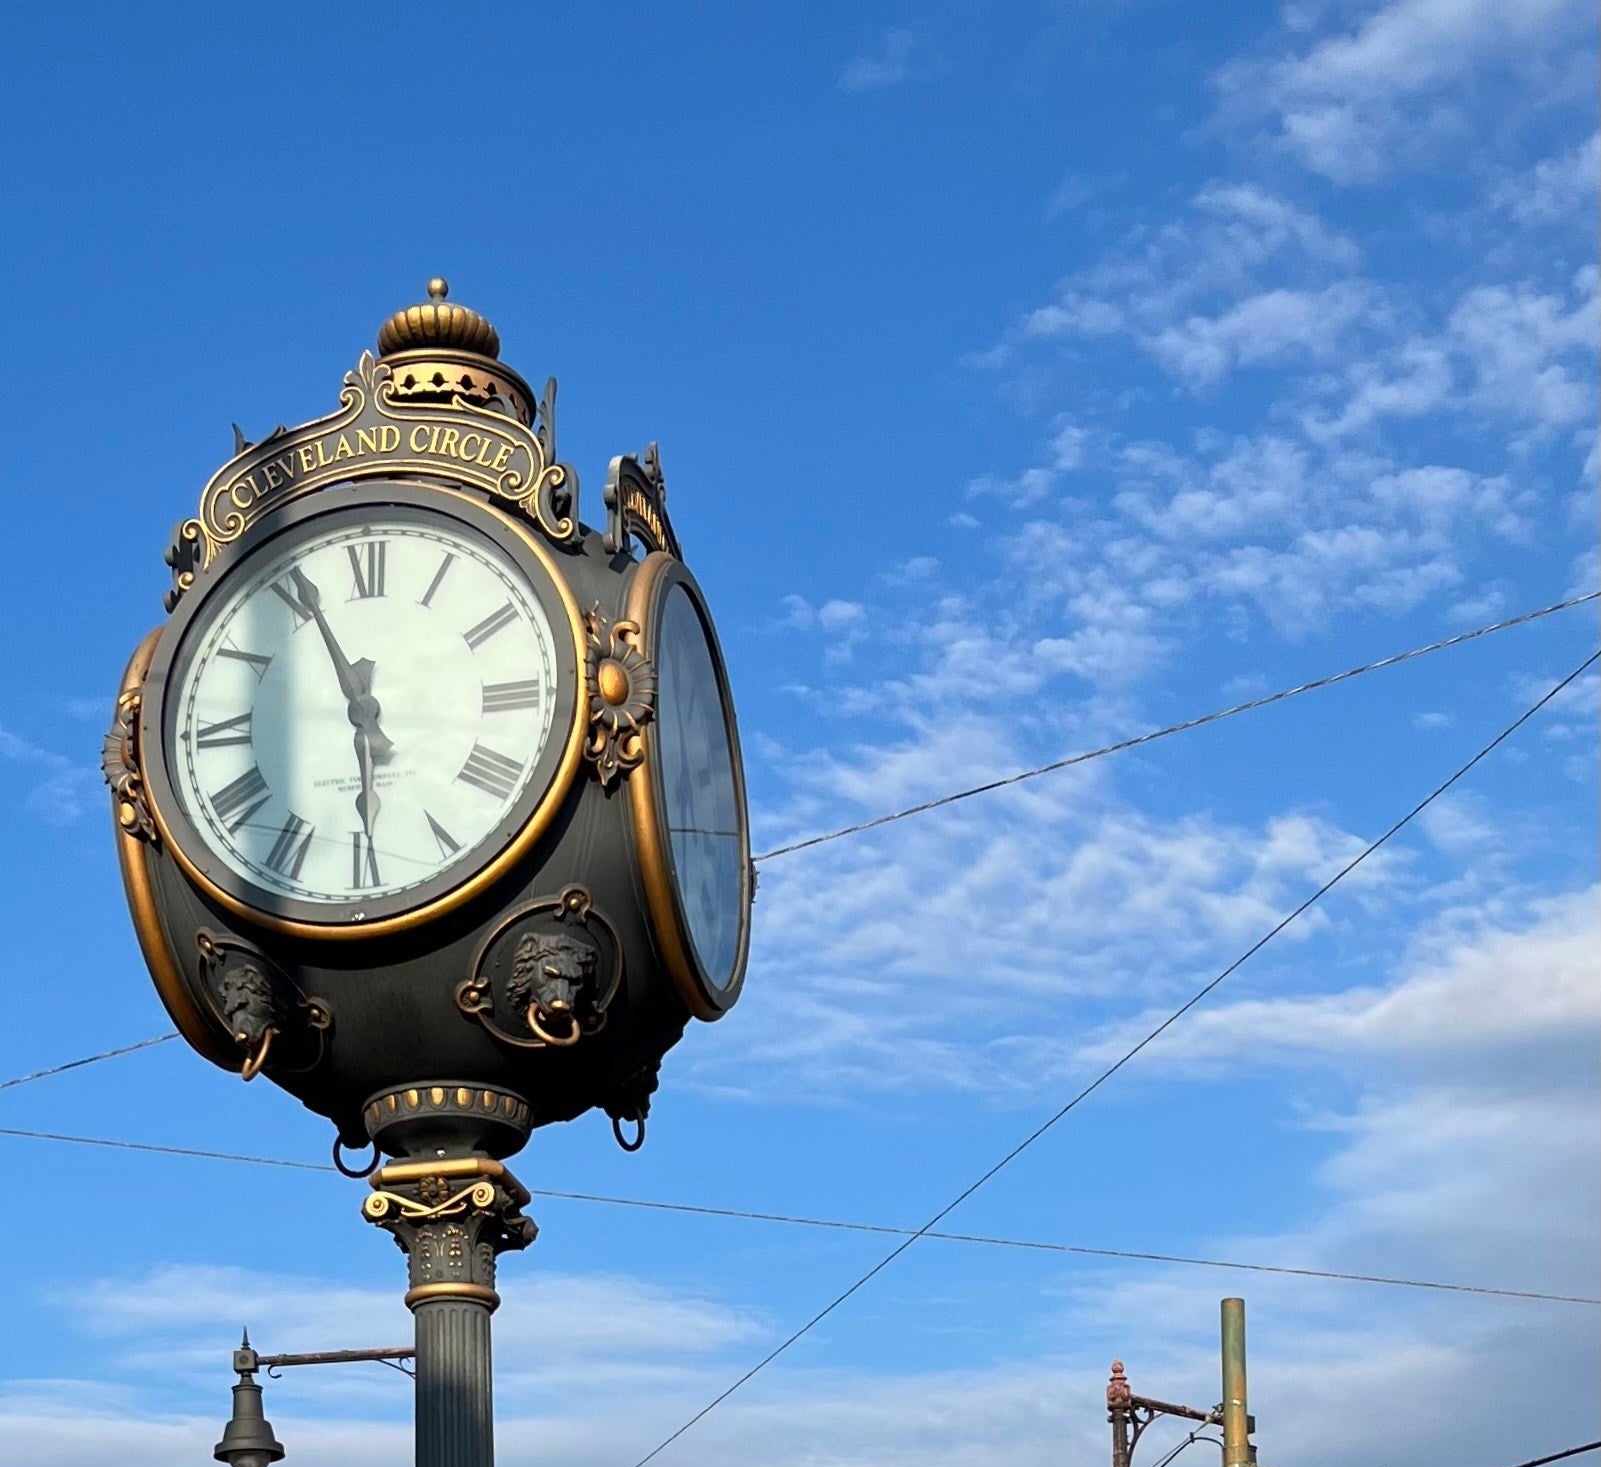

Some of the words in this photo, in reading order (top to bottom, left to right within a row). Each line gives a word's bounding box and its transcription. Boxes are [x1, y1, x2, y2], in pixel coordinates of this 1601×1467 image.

[230, 424, 401, 510] CLEVELAND
[408, 423, 515, 473] CIRCLE
[342, 539, 391, 603] XII
[414, 548, 461, 609] I
[460, 596, 523, 656] II
[212, 629, 276, 686] X
[480, 670, 540, 719] III
[196, 705, 254, 757] IX
[206, 759, 273, 840] VIII
[451, 736, 529, 809] IIII
[260, 809, 317, 884] VII
[344, 831, 390, 890] VI
[423, 808, 468, 864] V
